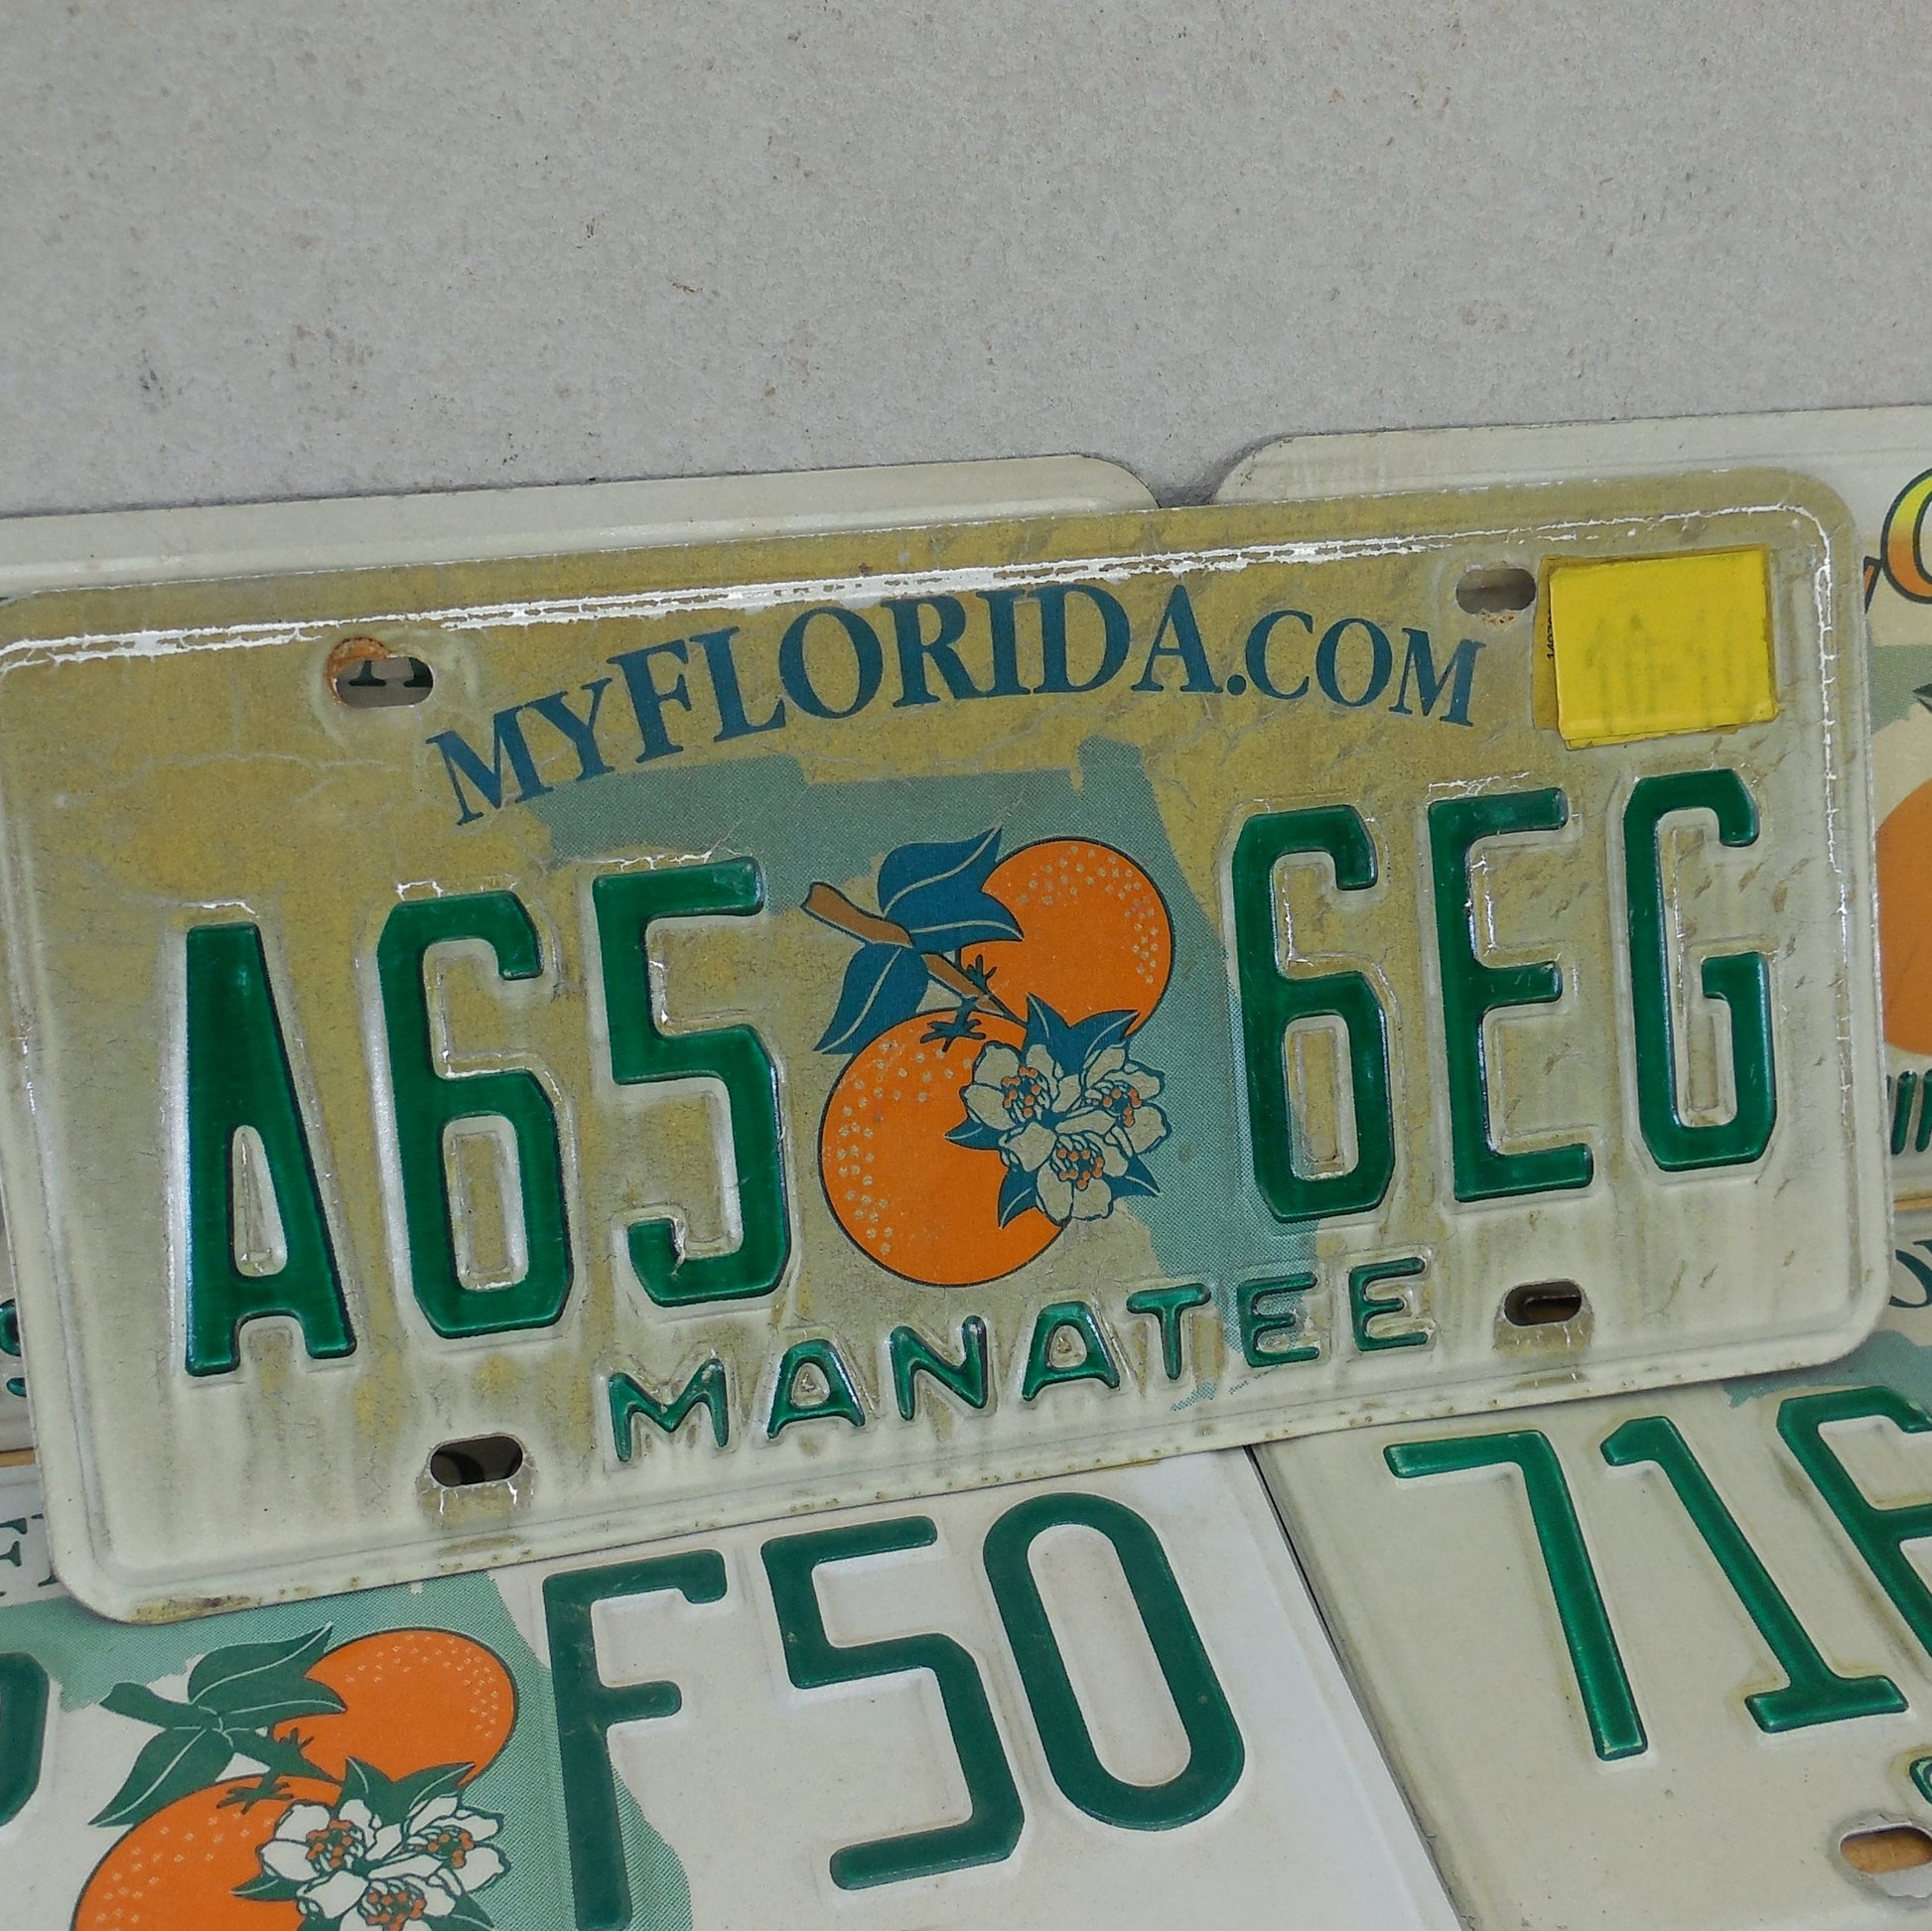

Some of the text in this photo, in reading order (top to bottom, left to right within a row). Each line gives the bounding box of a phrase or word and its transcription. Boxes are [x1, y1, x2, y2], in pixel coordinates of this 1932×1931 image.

[426, 584, 1485, 826] MYFLORIDA.COM
[186, 768, 1778, 1377] A65 6EG
[608, 1256, 1428, 1462] MANATEE
